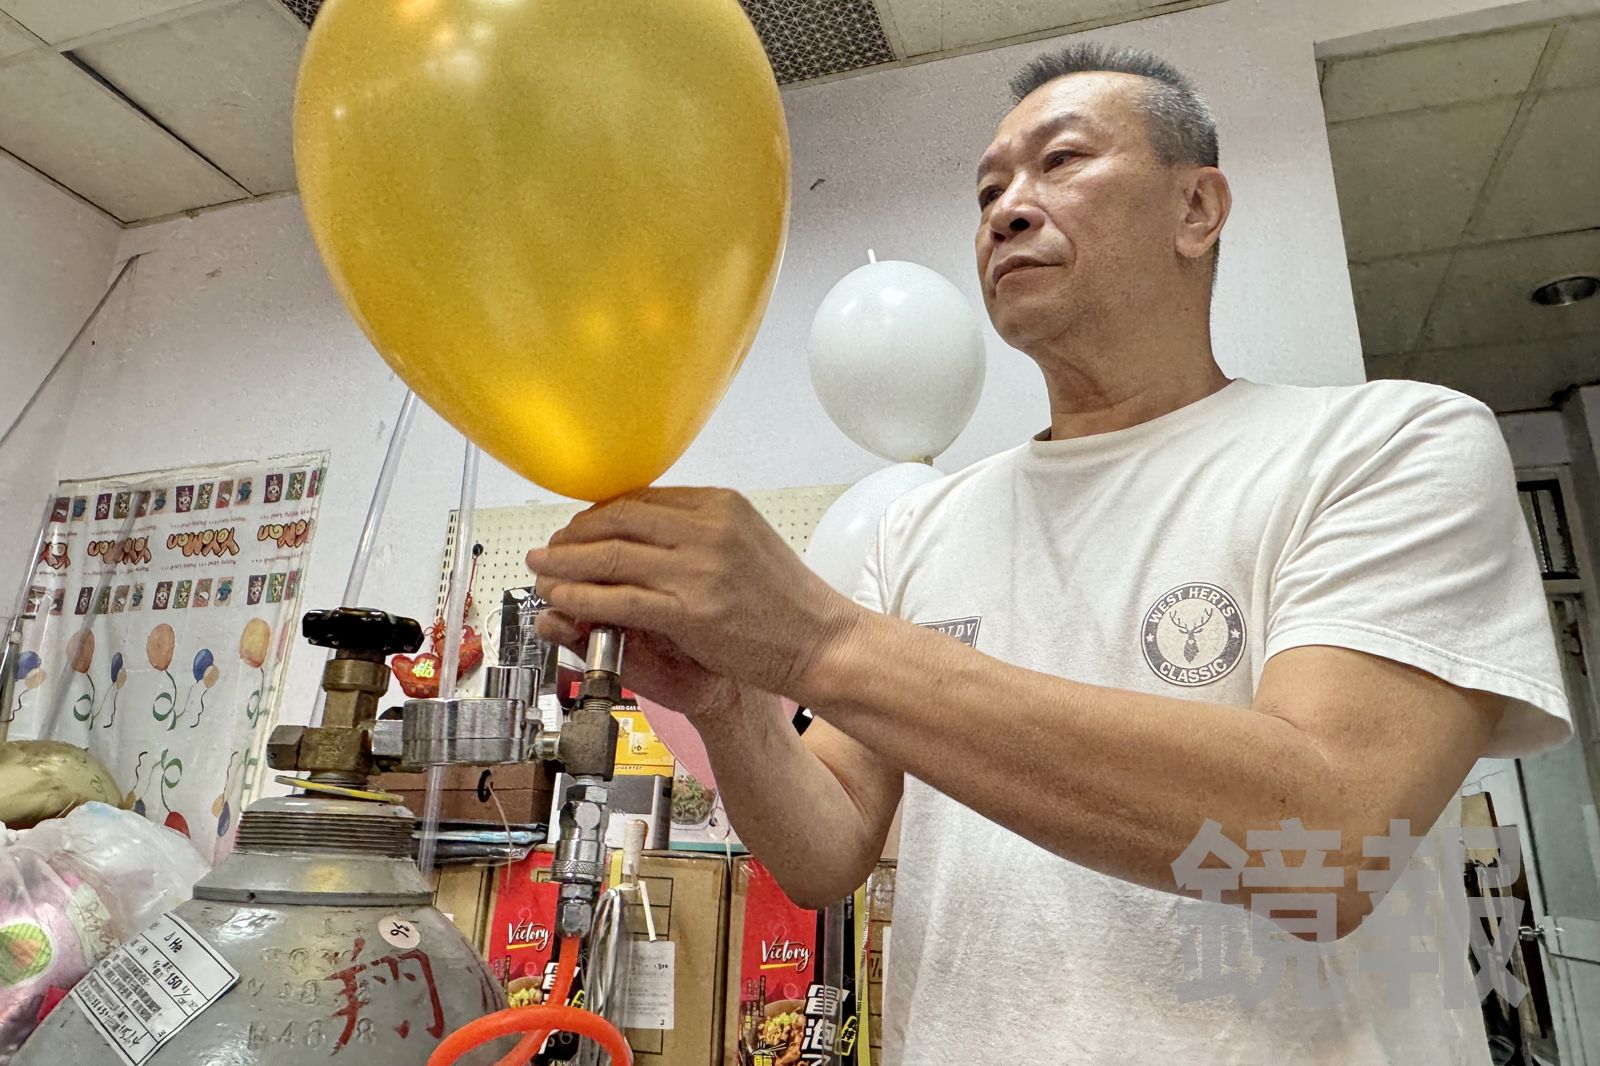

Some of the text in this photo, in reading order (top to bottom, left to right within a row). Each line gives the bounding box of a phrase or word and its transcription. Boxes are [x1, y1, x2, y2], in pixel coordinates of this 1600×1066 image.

[166, 527, 240, 558] YoYoMan
[1149, 587, 1235, 623] WEST HERTS
[1159, 658, 1227, 683] CLASSIC
[508, 918, 550, 950] Victory
[761, 936, 811, 972] Victory
[164, 972, 183, 990] 150
